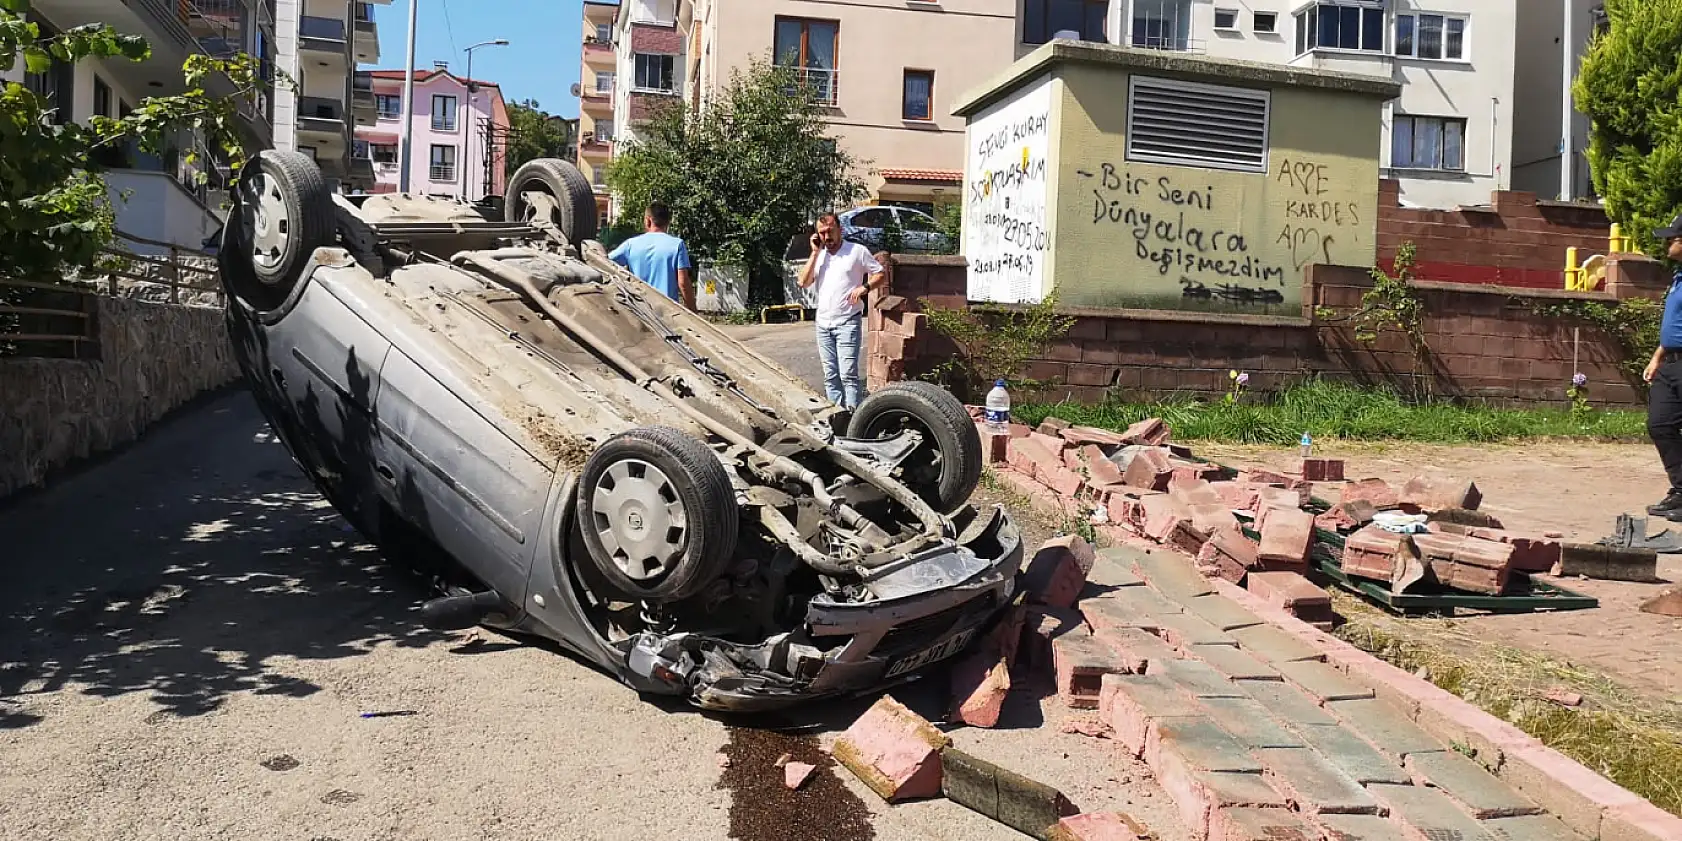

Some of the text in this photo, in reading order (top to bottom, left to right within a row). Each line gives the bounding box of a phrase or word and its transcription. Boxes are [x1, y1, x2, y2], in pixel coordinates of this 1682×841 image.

[1012, 111, 1048, 143] KURAY
[1101, 162, 1149, 195] Bir
[1159, 176, 1213, 210] Seni
[1093, 188, 1248, 253] Dünyalara
